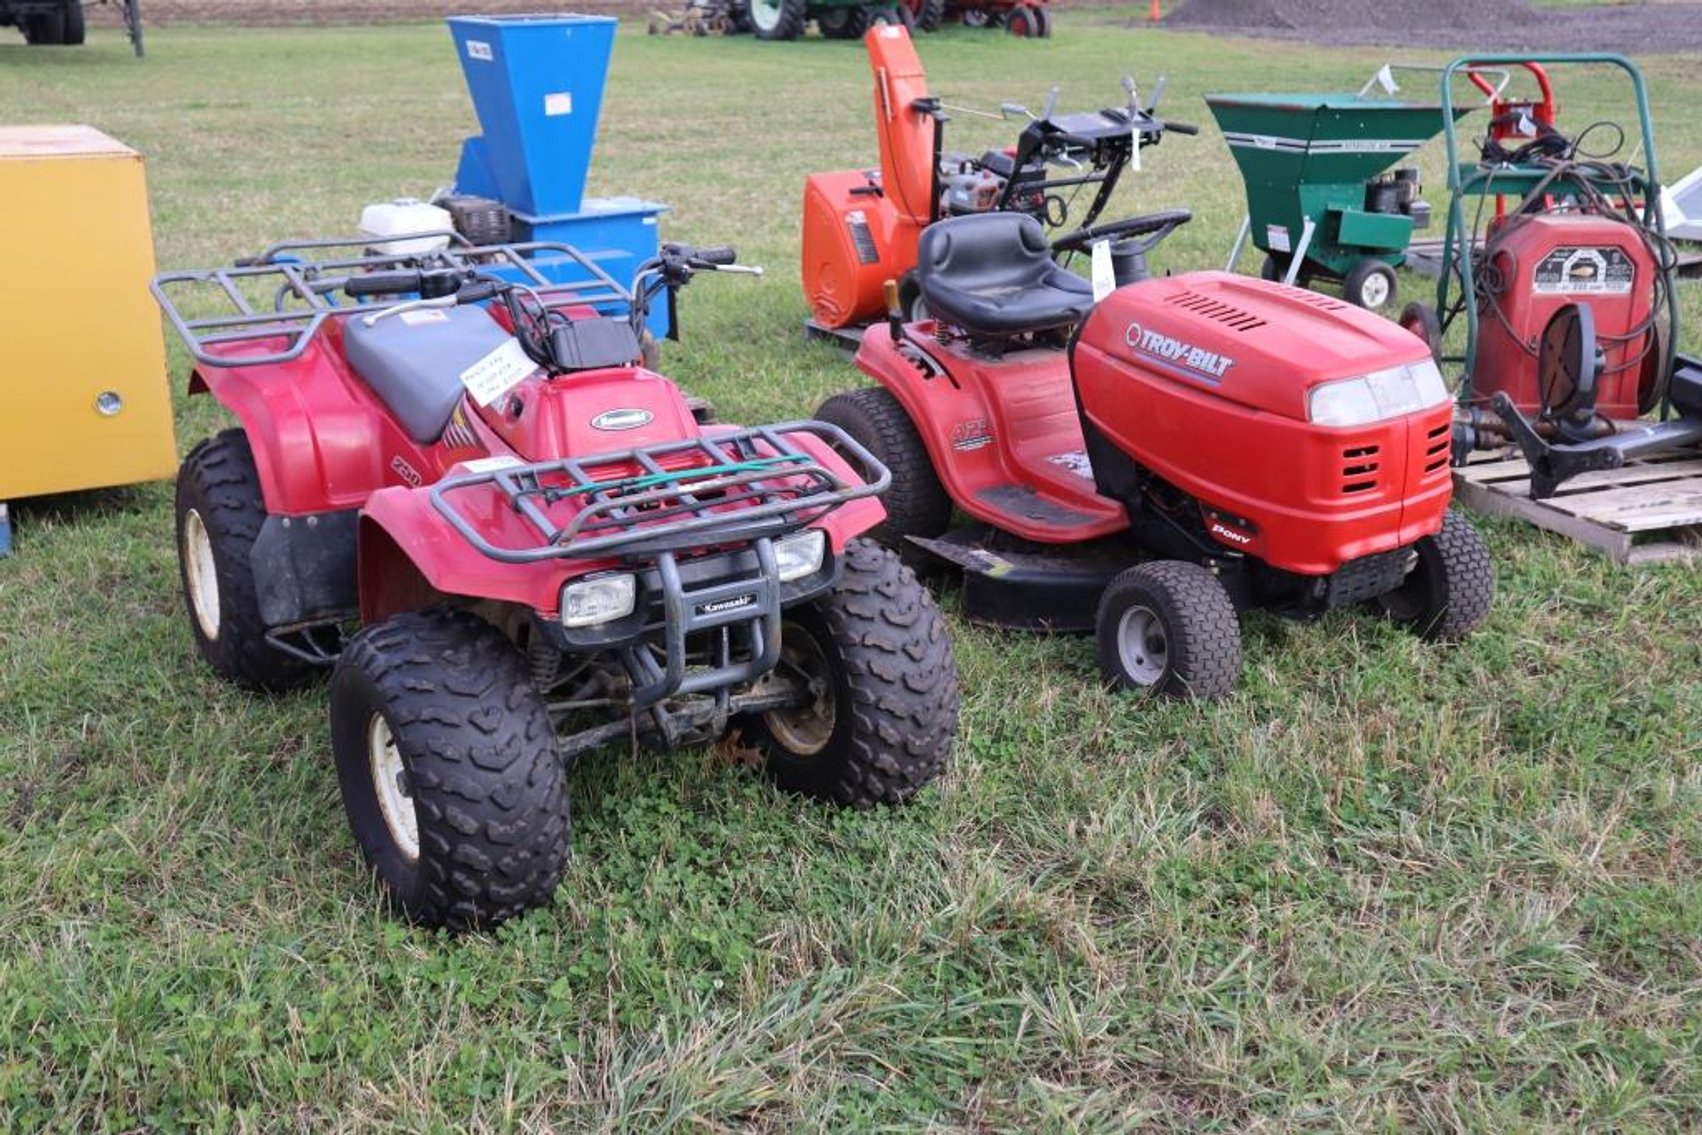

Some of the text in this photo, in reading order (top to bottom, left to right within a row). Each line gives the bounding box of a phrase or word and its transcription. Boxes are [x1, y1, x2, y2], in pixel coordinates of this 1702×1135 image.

[1141, 329, 1233, 377] TROY-BILT
[392, 457, 421, 488] 250
[699, 594, 752, 613] Kawasaki
